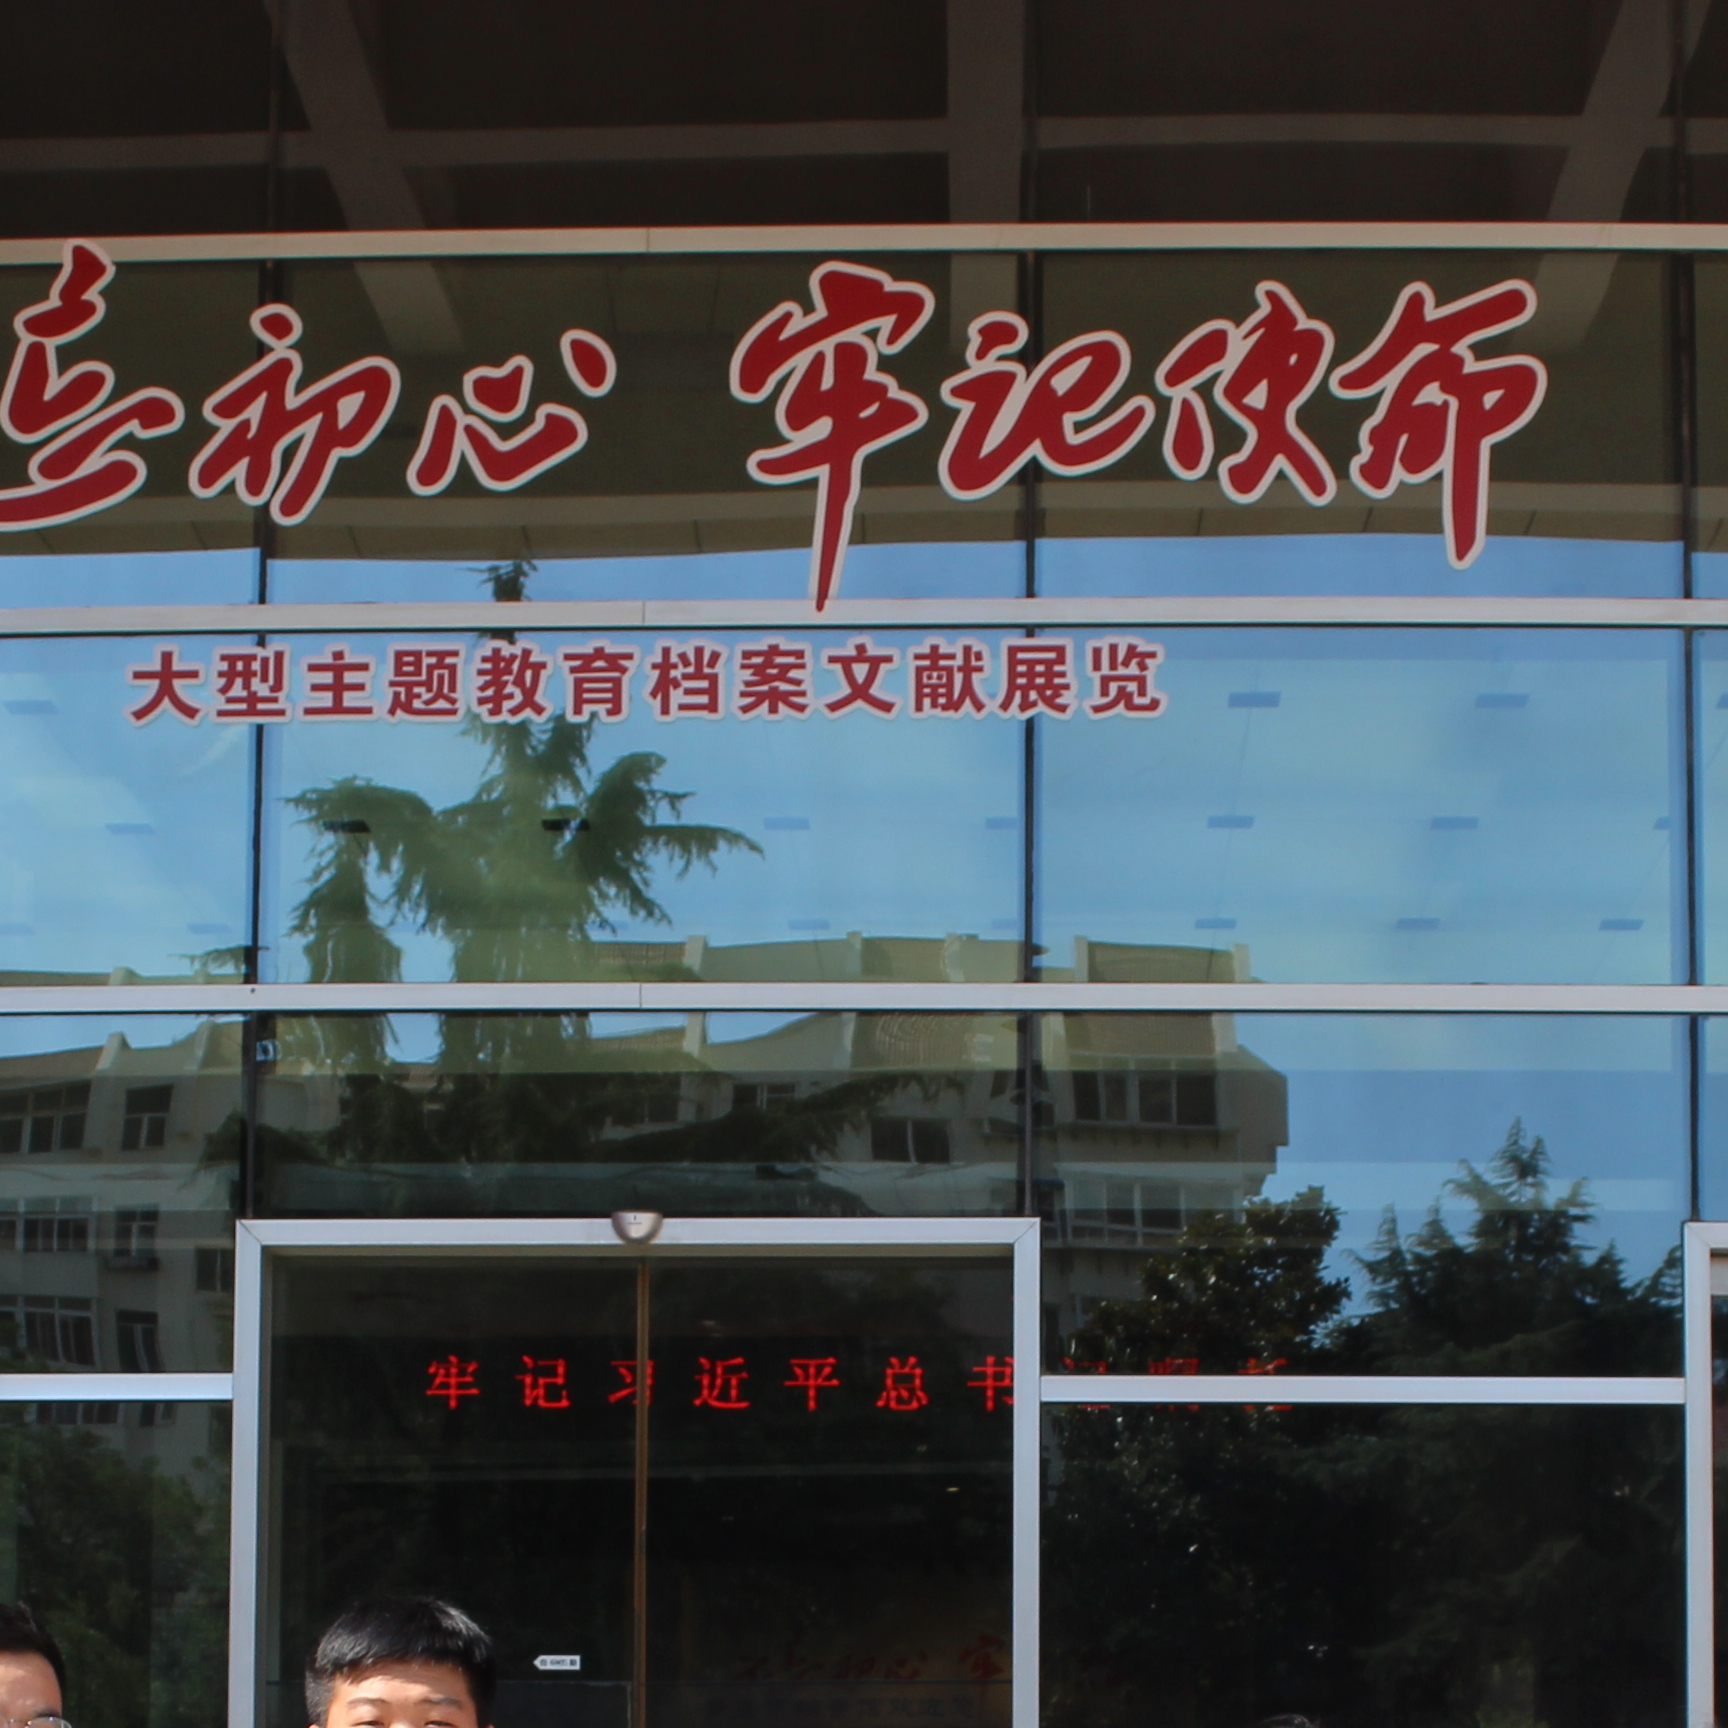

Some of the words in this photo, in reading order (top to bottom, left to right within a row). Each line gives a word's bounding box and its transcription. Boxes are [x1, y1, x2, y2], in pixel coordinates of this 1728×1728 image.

[729, 258, 1548, 614] 牢记使命
[127, 637, 1167, 724] 大型主题教育档案文献展览
